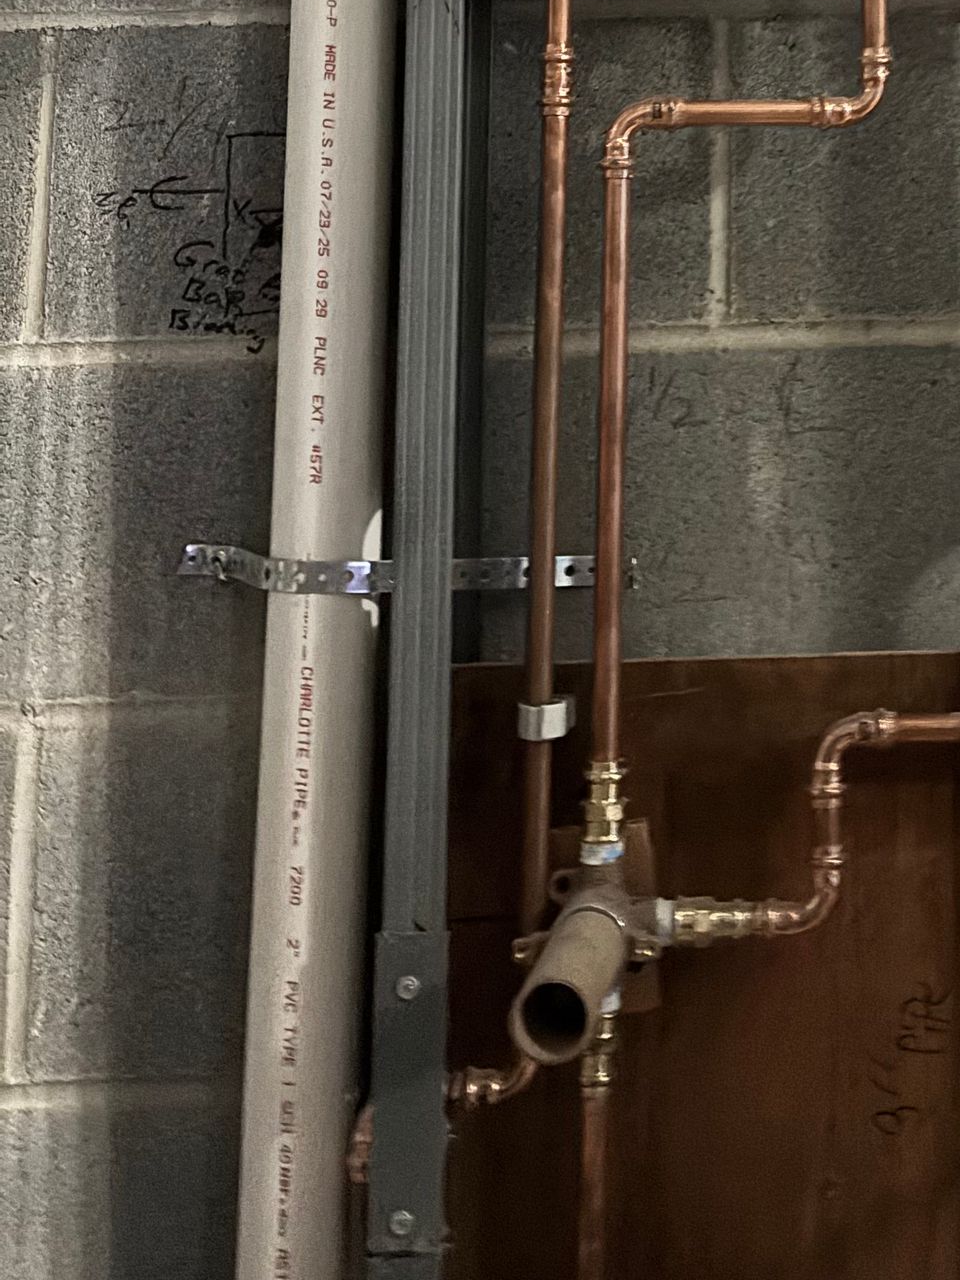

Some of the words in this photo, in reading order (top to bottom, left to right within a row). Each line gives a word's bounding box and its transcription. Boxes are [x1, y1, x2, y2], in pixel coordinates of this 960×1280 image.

[323, 43, 337, 81] MADE
[321, 91, 335, 110] IN
[312, 336, 327, 376] PLNC
[296, 665, 313, 759] CHARLOTTE
[288, 864, 304, 906] 7200
[286, 938, 301, 958] 2"
[284, 980, 300, 1013] PVC
[281, 1026, 298, 1067] TYPE
